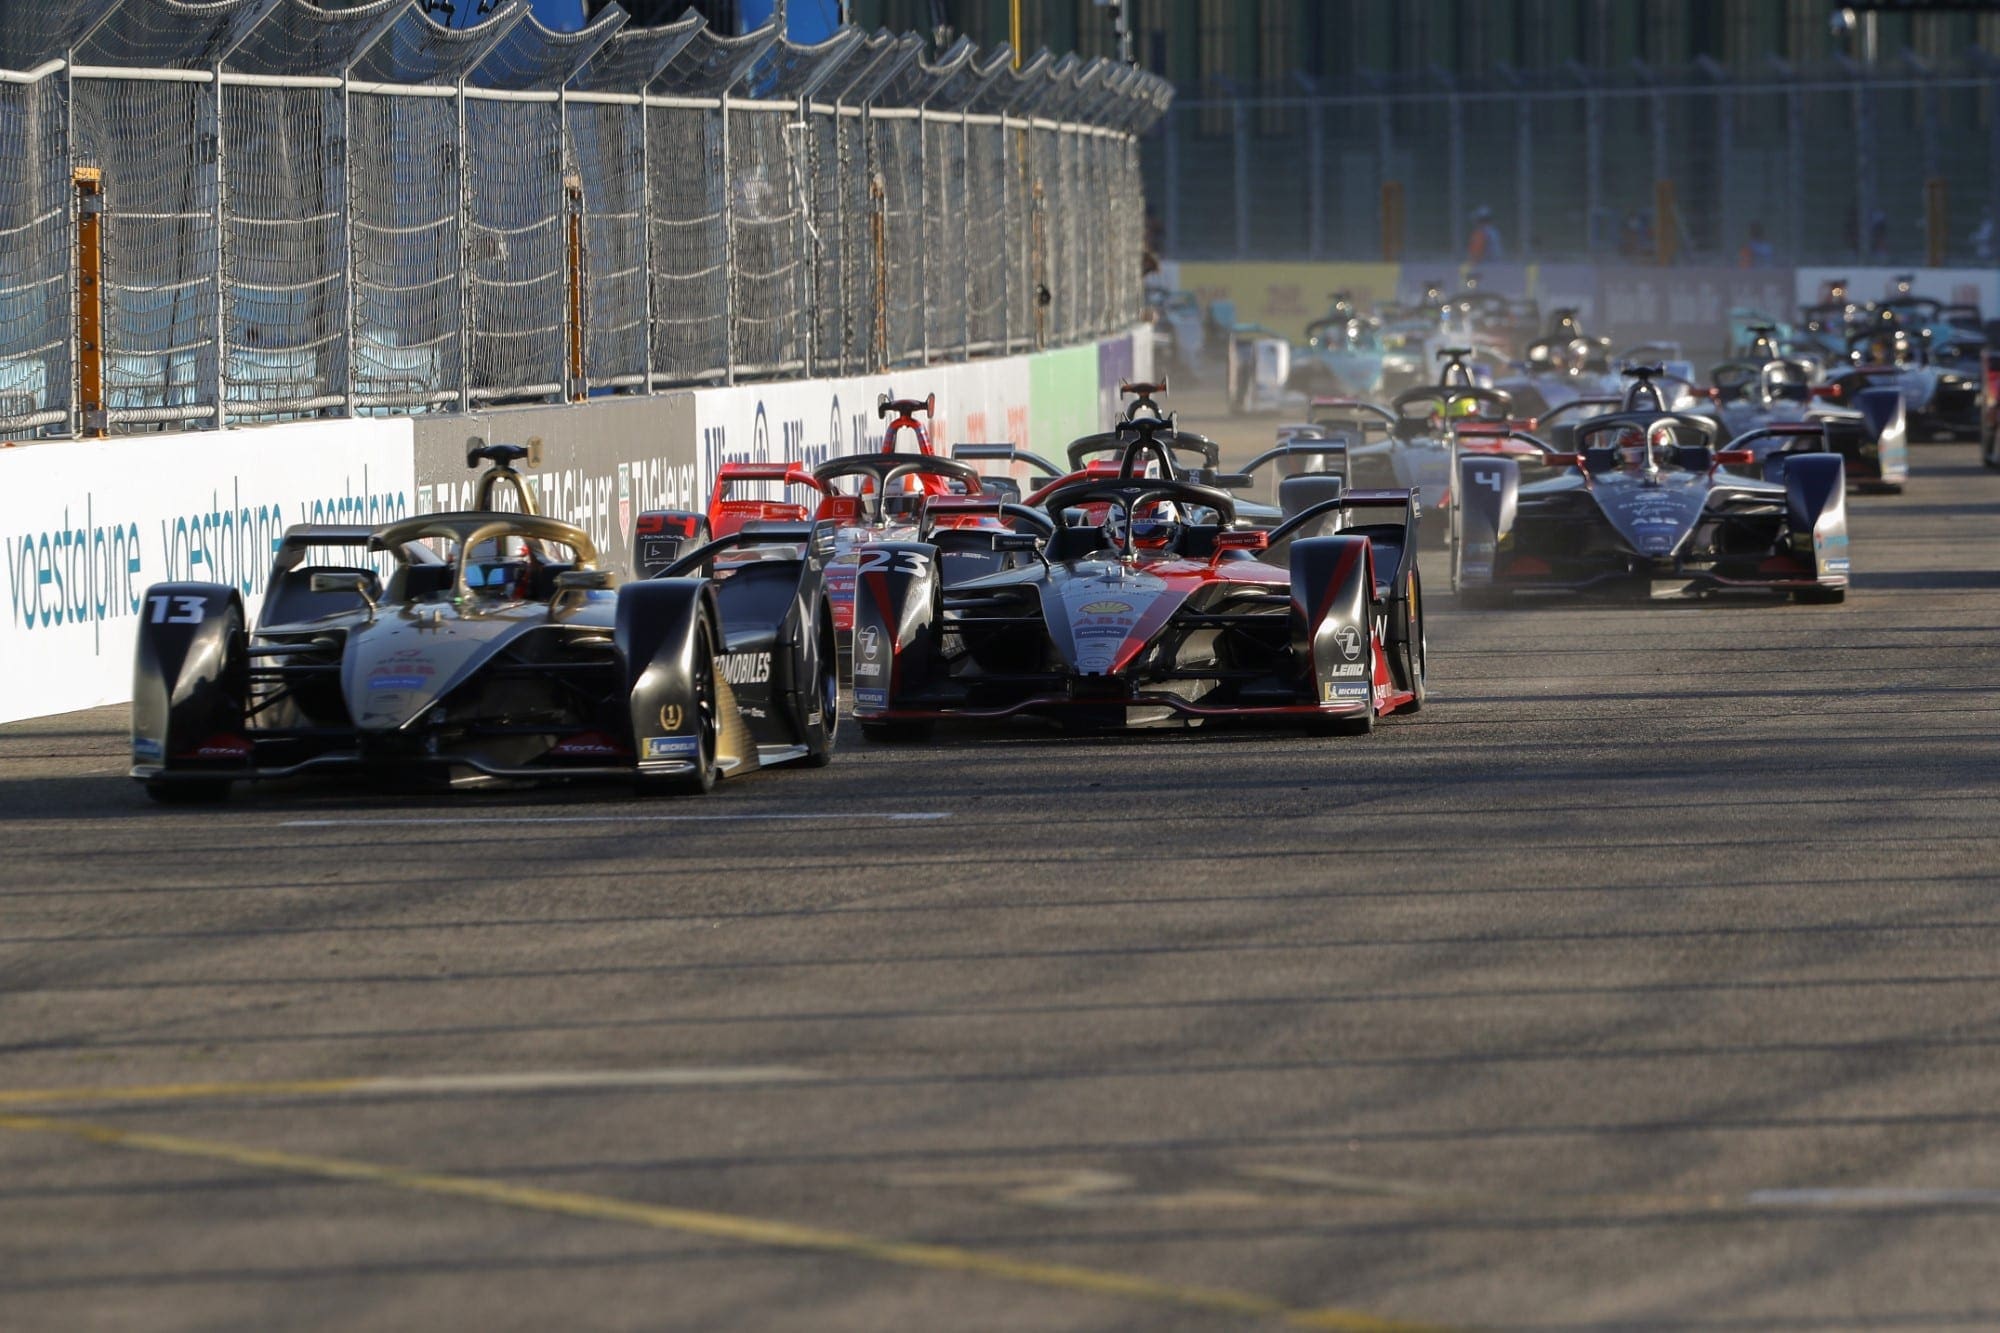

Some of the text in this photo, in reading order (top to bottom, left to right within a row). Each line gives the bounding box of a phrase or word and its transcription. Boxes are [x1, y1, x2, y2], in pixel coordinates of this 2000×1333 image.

[1474, 471, 1501, 492] 4
[7, 492, 141, 655] voestalpine
[856, 550, 930, 578] 23
[147, 595, 208, 624] 13
[1331, 663, 1364, 676] LEMO
